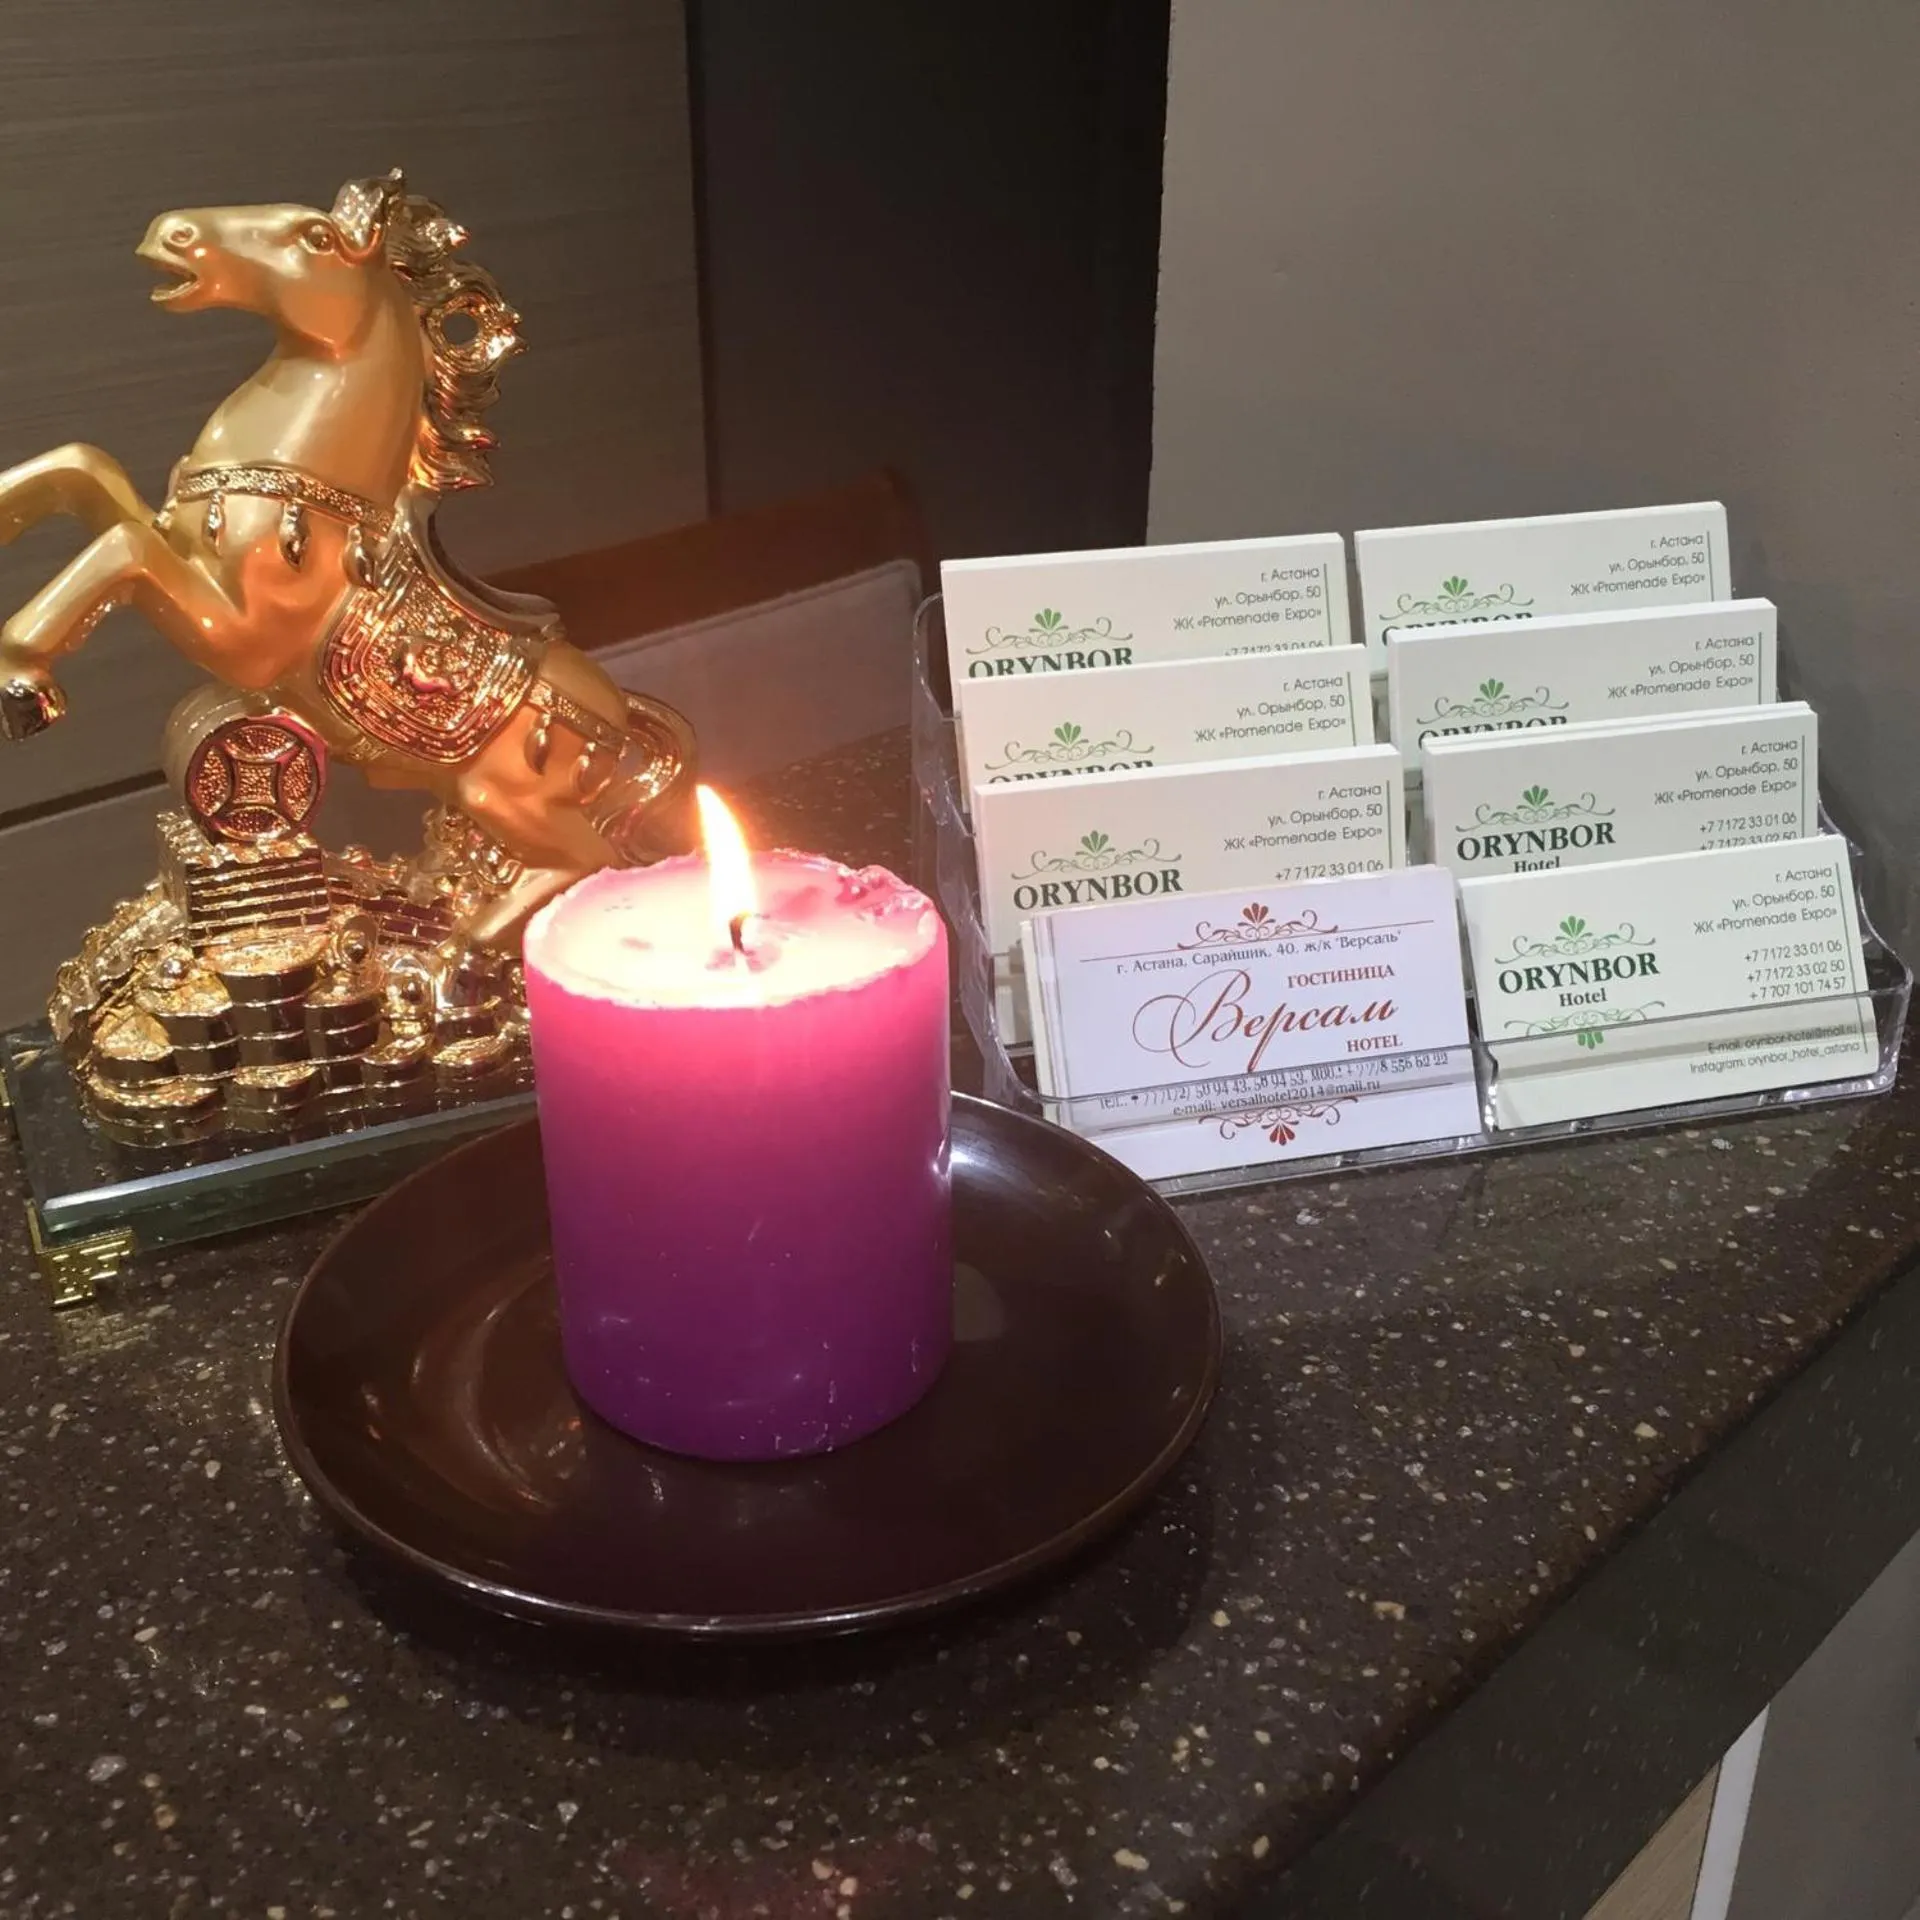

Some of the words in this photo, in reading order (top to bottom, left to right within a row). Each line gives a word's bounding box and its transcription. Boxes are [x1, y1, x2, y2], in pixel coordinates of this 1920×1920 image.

[1660, 534, 1703, 547] Астана
[1691, 552, 1704, 564] 50
[1272, 567, 1320, 581] Астана
[1306, 585, 1321, 598] 50
[1571, 584, 1590, 596] ЖК
[1173, 617, 1194, 630] ЖК
[1705, 636, 1754, 649] Астана
[1739, 654, 1754, 666] 50
[1294, 676, 1343, 690] Астана
[1608, 686, 1627, 699] ЖК
[1330, 694, 1345, 707] 50
[1195, 729, 1216, 742] ЖК
[1751, 739, 1797, 754] Астана
[1783, 758, 1798, 770] 50
[1329, 784, 1381, 799] Астана
[1654, 793, 1674, 805] ЖК
[1366, 804, 1382, 817] 50
[1700, 821, 1714, 832] +7
[1718, 817, 1746, 831] 7172
[1749, 815, 1762, 829] 33
[1765, 814, 1778, 827] 01
[1782, 812, 1797, 824] 06
[1224, 837, 1245, 850] ЖК
[1457, 822, 1616, 861] ORYNBOR
[1276, 868, 1290, 880] +7
[1295, 864, 1326, 880] 7172
[1329, 863, 1344, 876] 33
[1348, 861, 1362, 874] 01
[1367, 860, 1383, 872] 06
[1514, 856, 1560, 873] Hotel
[1785, 867, 1832, 882] Астана
[1013, 869, 1183, 910] ORYNBOR
[1820, 885, 1835, 898] 50
[1694, 922, 1714, 934] ЖК
[1133, 957, 1187, 972] Астана,
[1304, 940, 1332, 952] ж/к
[1744, 950, 1758, 961] +7
[1762, 945, 1791, 961] 7172
[1794, 944, 1808, 956] 33
[1810, 942, 1824, 954] 01
[1827, 940, 1842, 952] 06
[1288, 964, 1395, 988] ГОСТИНИЦА
[1499, 952, 1660, 994] ORYNBOR
[1747, 970, 1760, 981] +7
[1765, 966, 1793, 980] 7172
[1797, 964, 1810, 976] 33
[1813, 961, 1827, 974] 02
[1831, 960, 1844, 972] 50
[1770, 984, 1790, 997] 707
[1795, 981, 1813, 994] 101
[1817, 979, 1831, 990] 74
[1834, 976, 1845, 989] 57
[1559, 988, 1607, 1007] Hotel
[1132, 967, 1399, 1073] Версаль
[1347, 1035, 1402, 1052] HOTEL
[1173, 1103, 1216, 1116] e-mail:
